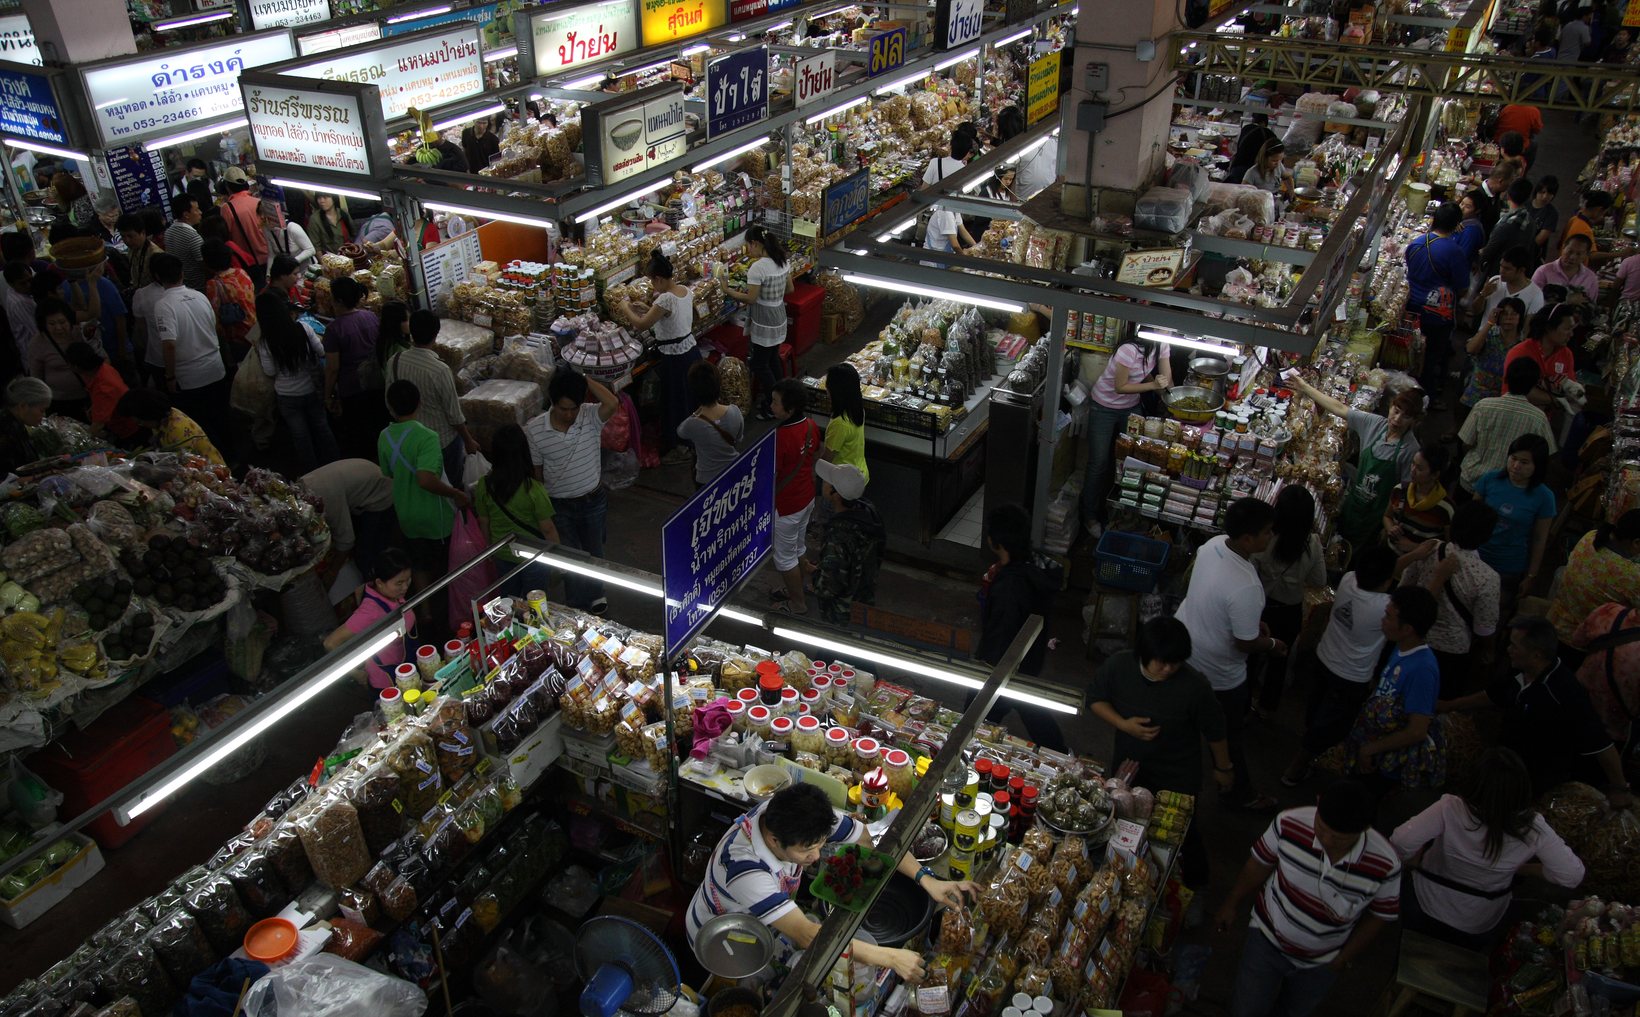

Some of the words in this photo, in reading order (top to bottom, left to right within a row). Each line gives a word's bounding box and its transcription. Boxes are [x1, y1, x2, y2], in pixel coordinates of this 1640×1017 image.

[668, 2, 704, 35] สุจินต์
[397, 39, 477, 73] แหนมป้าย่น
[559, 25, 618, 66] ป้าย่น
[872, 32, 903, 73] มล
[151, 49, 244, 88] ดำรงค์
[799, 61, 832, 100] ป้าย่น
[105, 99, 148, 121] หมูทอด
[153, 89, 182, 107] ไส้อั่ว
[250, 90, 349, 124] ร้านศรีพรรณ
[252, 123, 284, 140] หมูทอด
[283, 120, 310, 142] ไส้อั่ว
[311, 123, 363, 151] น้ำพริกหนุ่ม
[690, 503, 756, 576] น้ำพริกหนุ่ม
[732, 547, 758, 583] 251737
